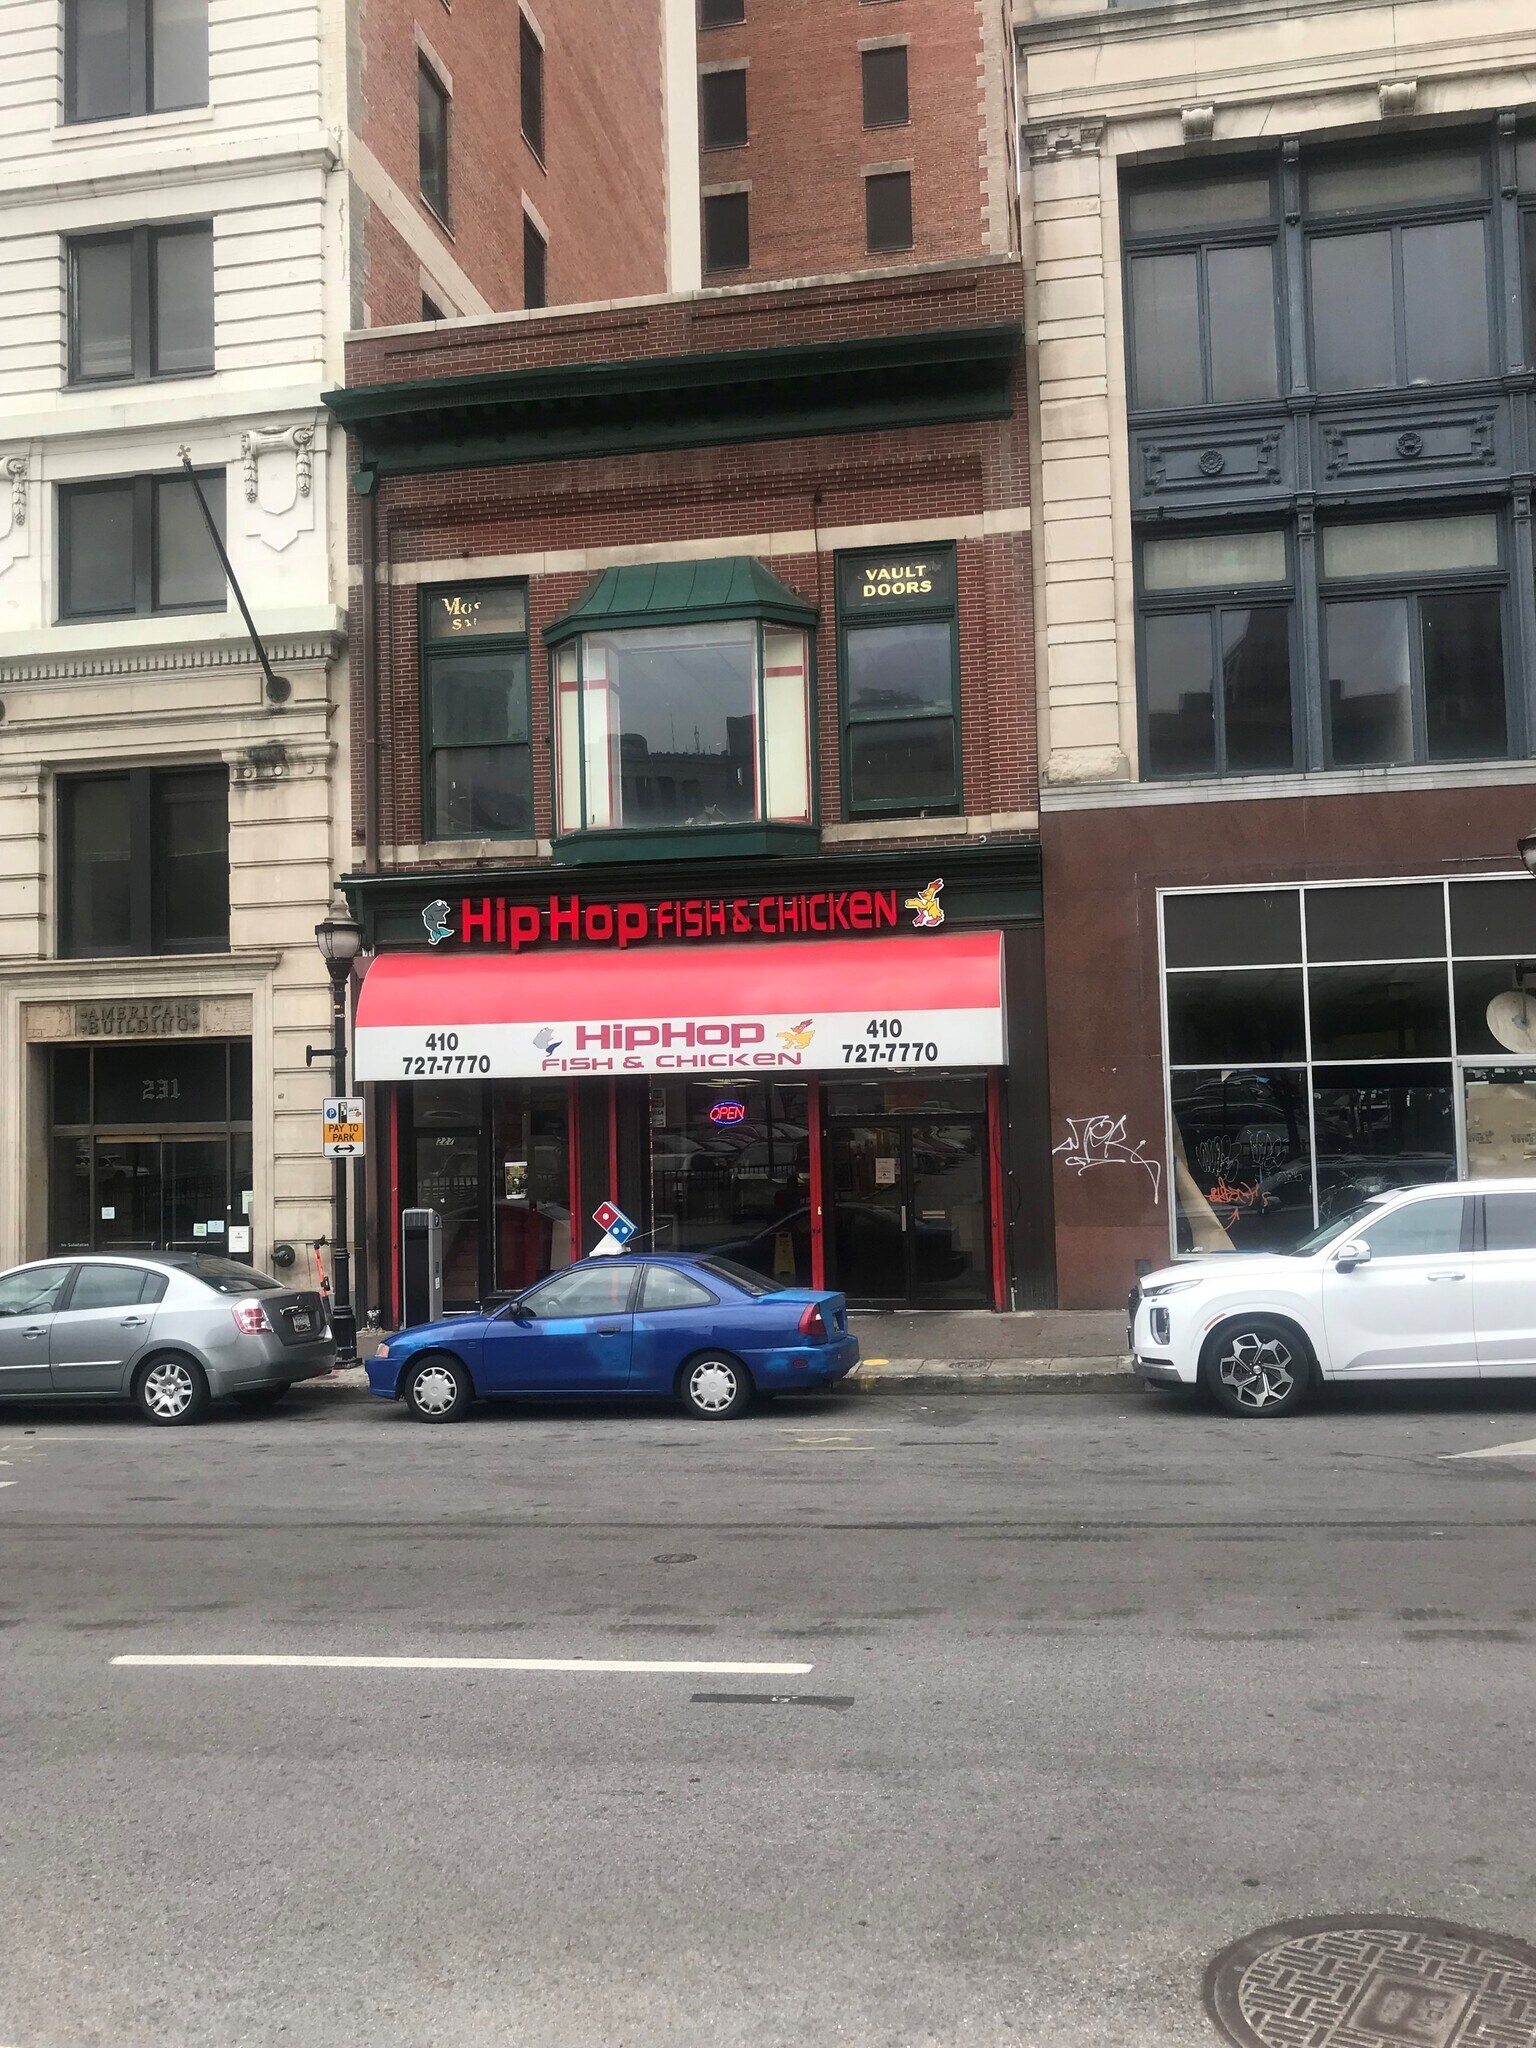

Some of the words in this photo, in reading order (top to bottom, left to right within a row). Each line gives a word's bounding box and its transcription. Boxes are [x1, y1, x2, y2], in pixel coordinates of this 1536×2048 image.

[865, 565, 927, 581] VAULT
[863, 580, 932, 597] DOORS
[656, 899, 726, 938] FISH
[732, 899, 754, 932] &
[88, 1004, 189, 1021] AMERICAN
[88, 1018, 190, 1035] BUILDING
[866, 1018, 902, 1039] 410
[425, 1032, 459, 1052] 410
[842, 1041, 939, 1064] 727-7770
[402, 1054, 491, 1075] 727-7770
[542, 1056, 613, 1072] FISH
[622, 1055, 645, 1070] &
[142, 1078, 181, 1100] 231
[709, 1105, 746, 1121] OPEN
[328, 1124, 345, 1133] PAY
[348, 1123, 359, 1133] TO
[332, 1133, 355, 1142] PARK
[436, 1136, 456, 1146] 227
